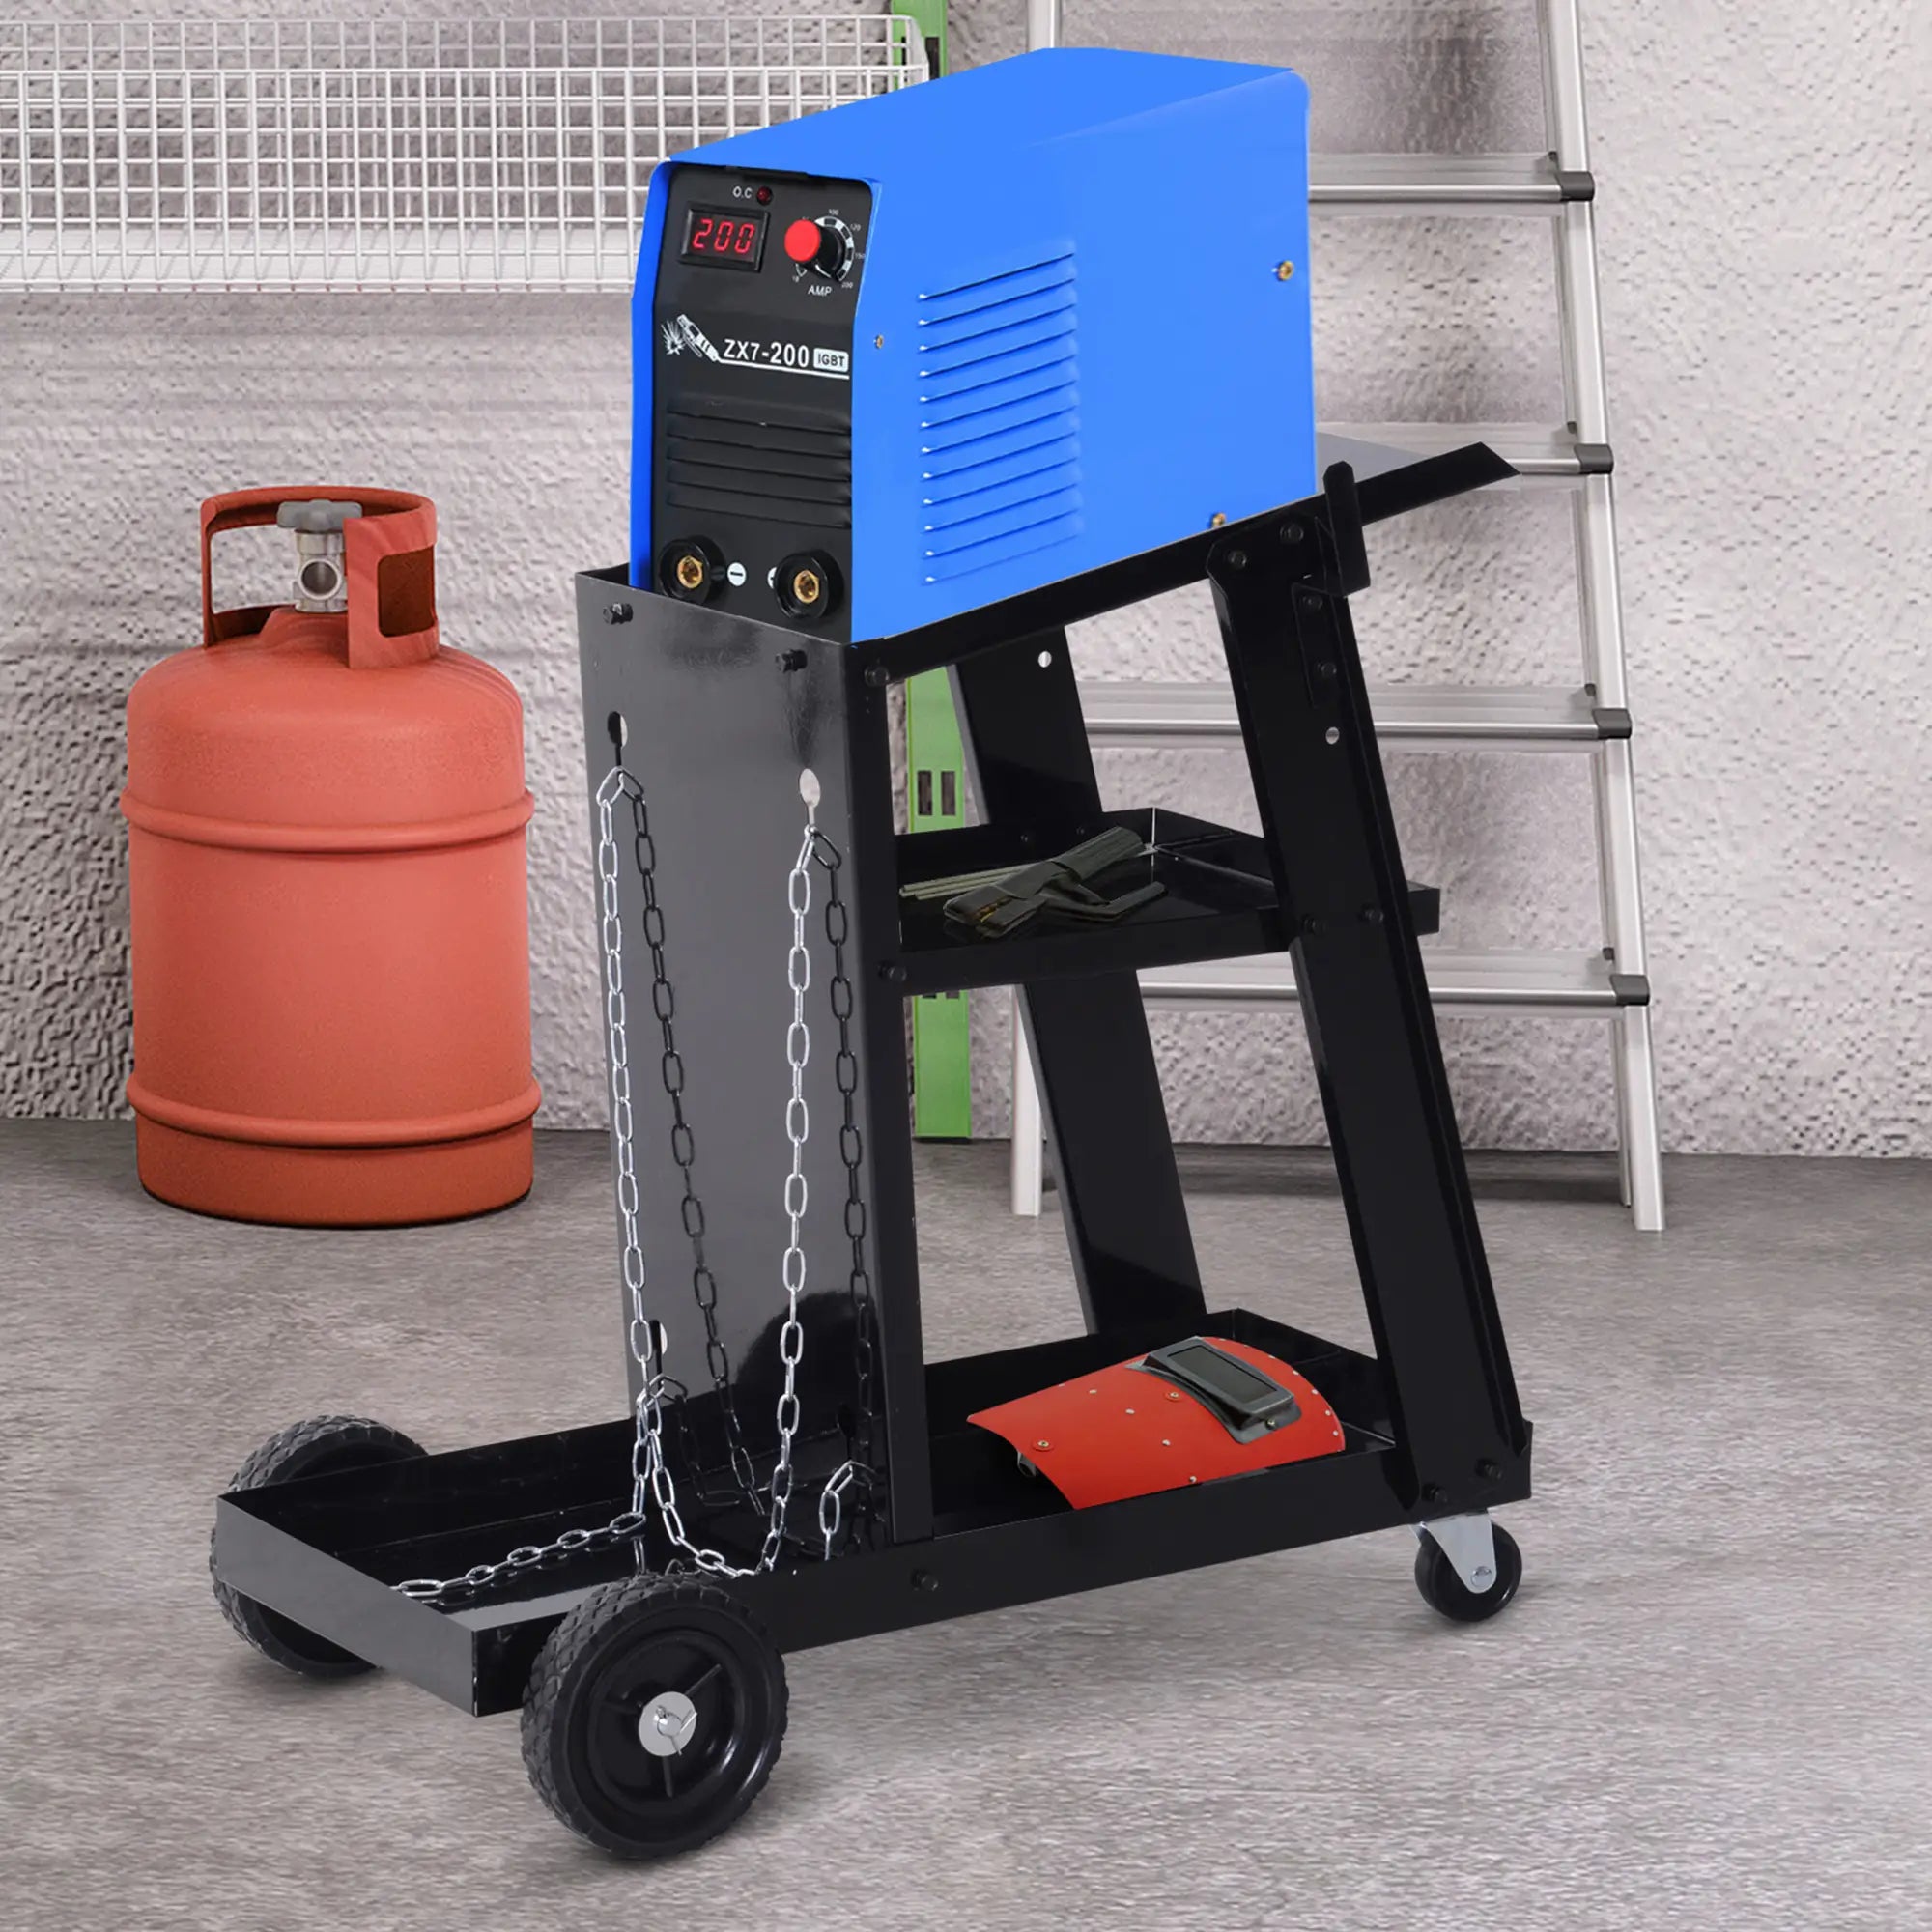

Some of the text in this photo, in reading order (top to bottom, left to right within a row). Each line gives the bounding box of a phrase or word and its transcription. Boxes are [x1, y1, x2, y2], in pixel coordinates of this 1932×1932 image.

[732, 186, 753, 199] O.C
[692, 218, 755, 254] 200
[808, 285, 833, 297] AMP
[724, 339, 845, 368] ZX7-200 IGBT
